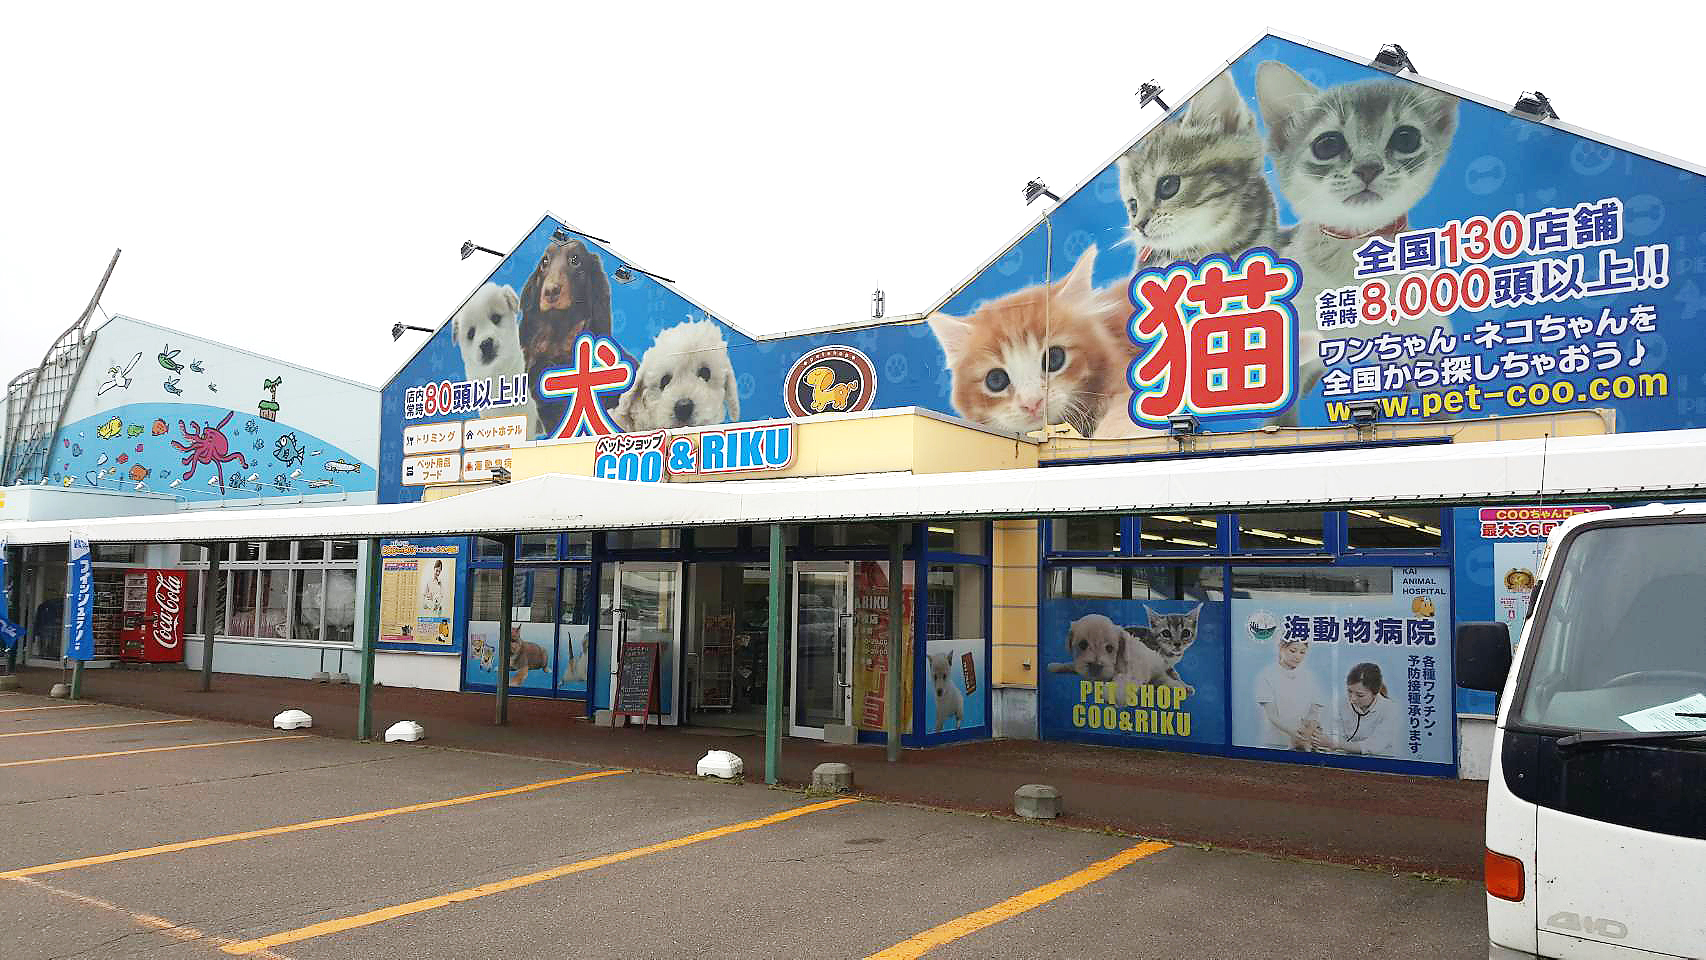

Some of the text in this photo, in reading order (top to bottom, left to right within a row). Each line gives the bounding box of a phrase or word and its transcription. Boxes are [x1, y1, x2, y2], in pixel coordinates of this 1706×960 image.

[1356, 201, 1619, 276] 全国130店舗
[1318, 290, 1356, 309] 全店
[1361, 248, 1665, 322] 8,000頭以上!!
[1319, 308, 1358, 327] 常時
[1133, 253, 1296, 422] 猫
[540, 336, 633, 438] 犬
[1326, 372, 1668, 423] ww.pet-coo.com
[416, 430, 456, 444] トリミング
[476, 424, 523, 438] ペットホテル
[597, 433, 663, 452] ペットショップ
[669, 441, 695, 470] &
[702, 427, 789, 470] RIKU
[1284, 615, 1436, 646] 海動物病院
[1125, 682, 1188, 710] SHOP
[1072, 703, 1192, 737] COO&RIKU
